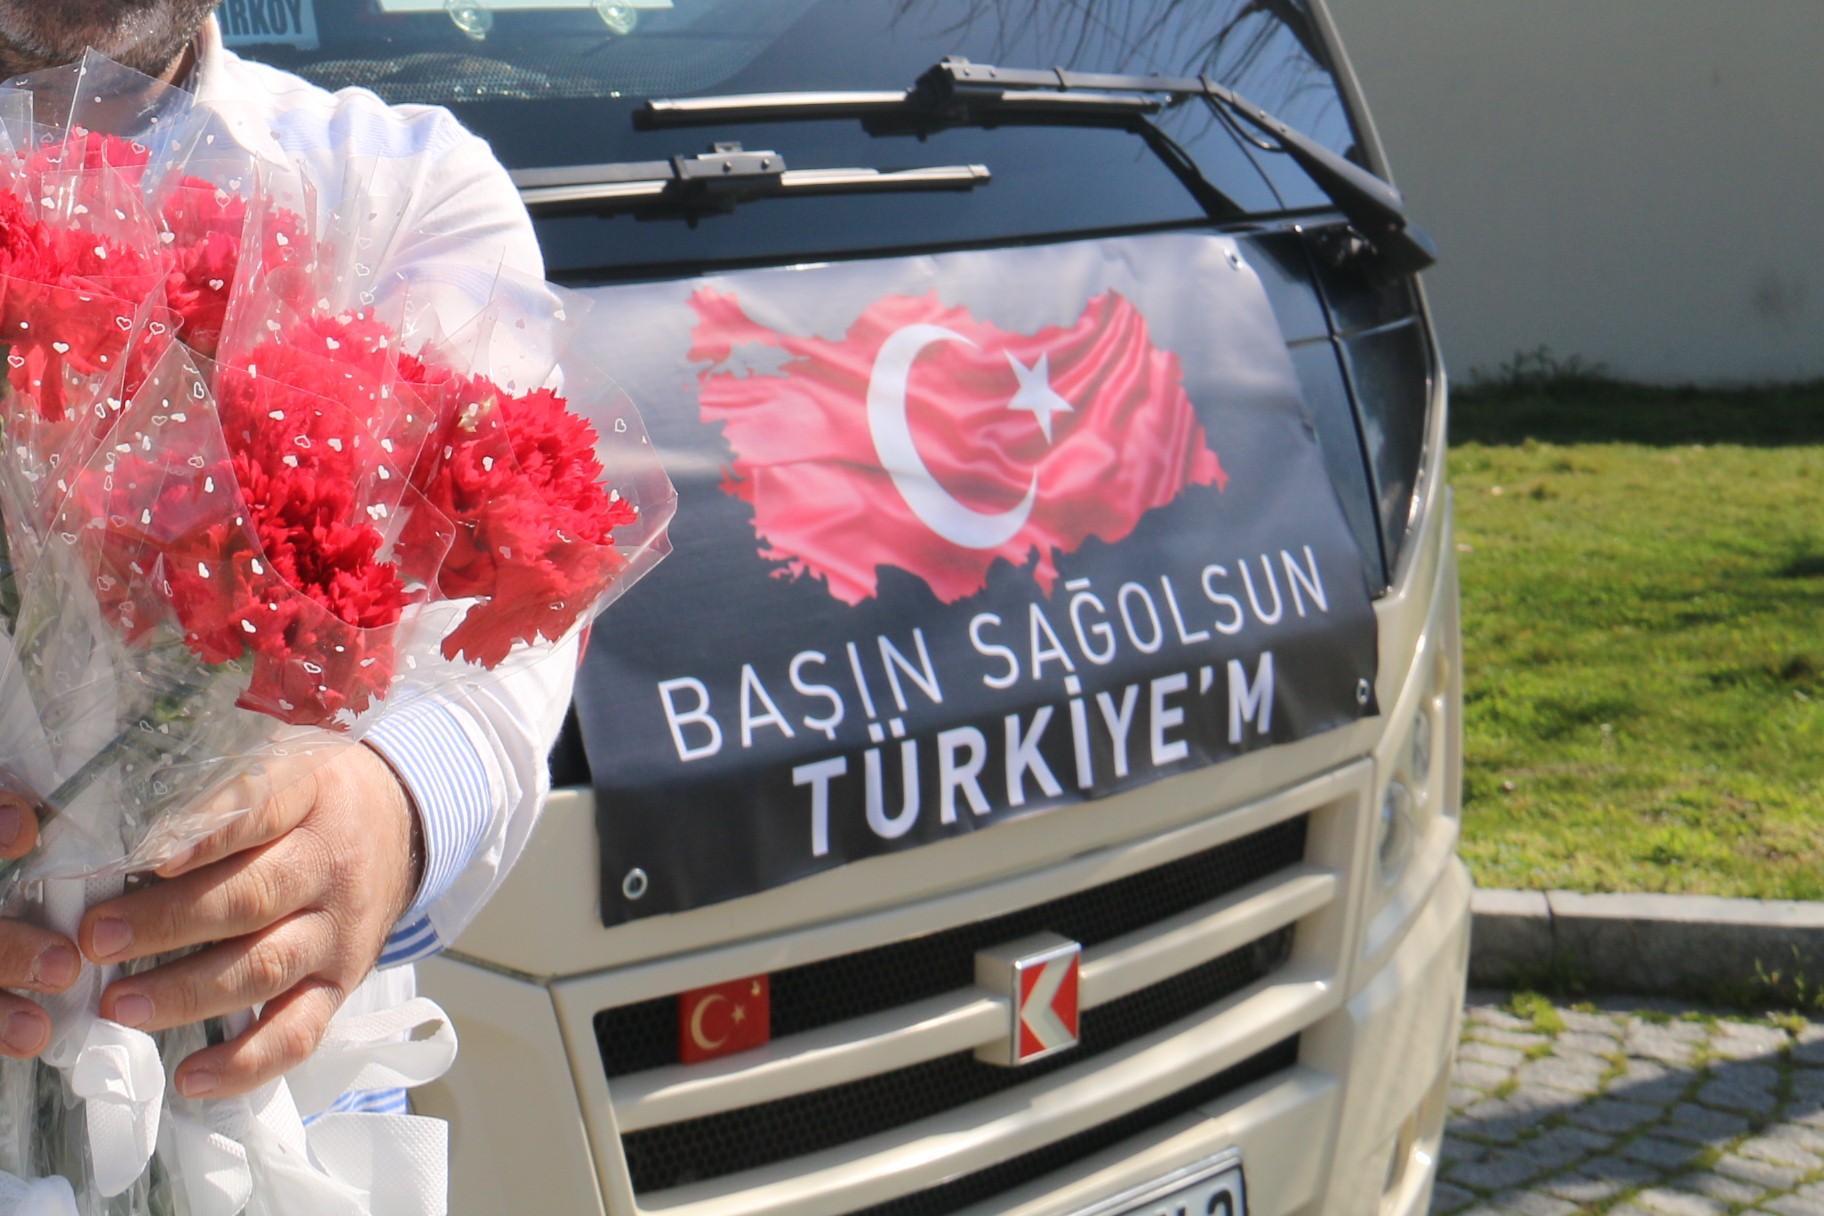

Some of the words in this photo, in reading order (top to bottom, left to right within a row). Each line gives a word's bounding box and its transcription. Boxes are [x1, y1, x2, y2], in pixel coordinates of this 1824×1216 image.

[657, 627, 944, 762] BAŞIN
[968, 545, 1328, 689] SAĞOLSUN
[792, 651, 1275, 857] TÜRKİYE'M
